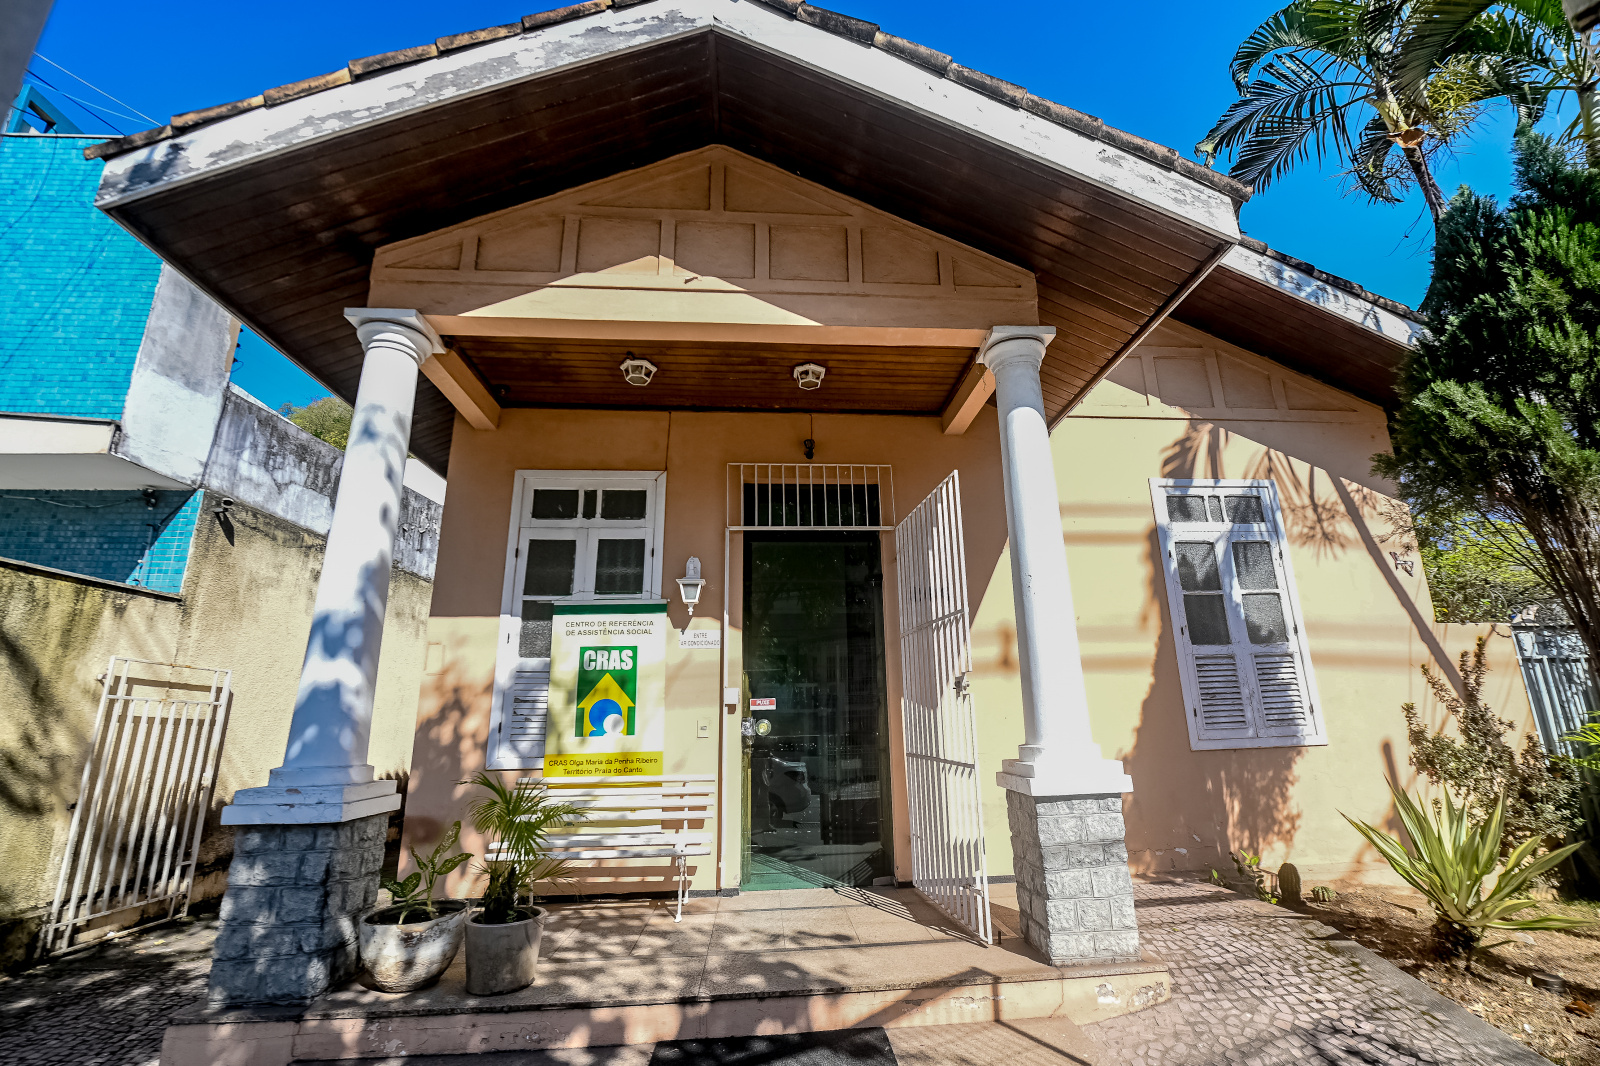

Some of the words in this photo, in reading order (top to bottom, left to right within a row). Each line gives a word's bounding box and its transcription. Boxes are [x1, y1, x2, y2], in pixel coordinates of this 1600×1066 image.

[608, 619, 654, 627] REFERÊNCIA
[577, 627, 625, 636] ASSISTÊNCIA
[583, 649, 634, 671] CRAS
[548, 759, 568, 767] CRAS
[569, 759, 584, 767] Olga
[613, 757, 634, 765] Penha
[562, 767, 593, 775] Território
[613, 766, 622, 774] do
[623, 766, 643, 774] Canto
